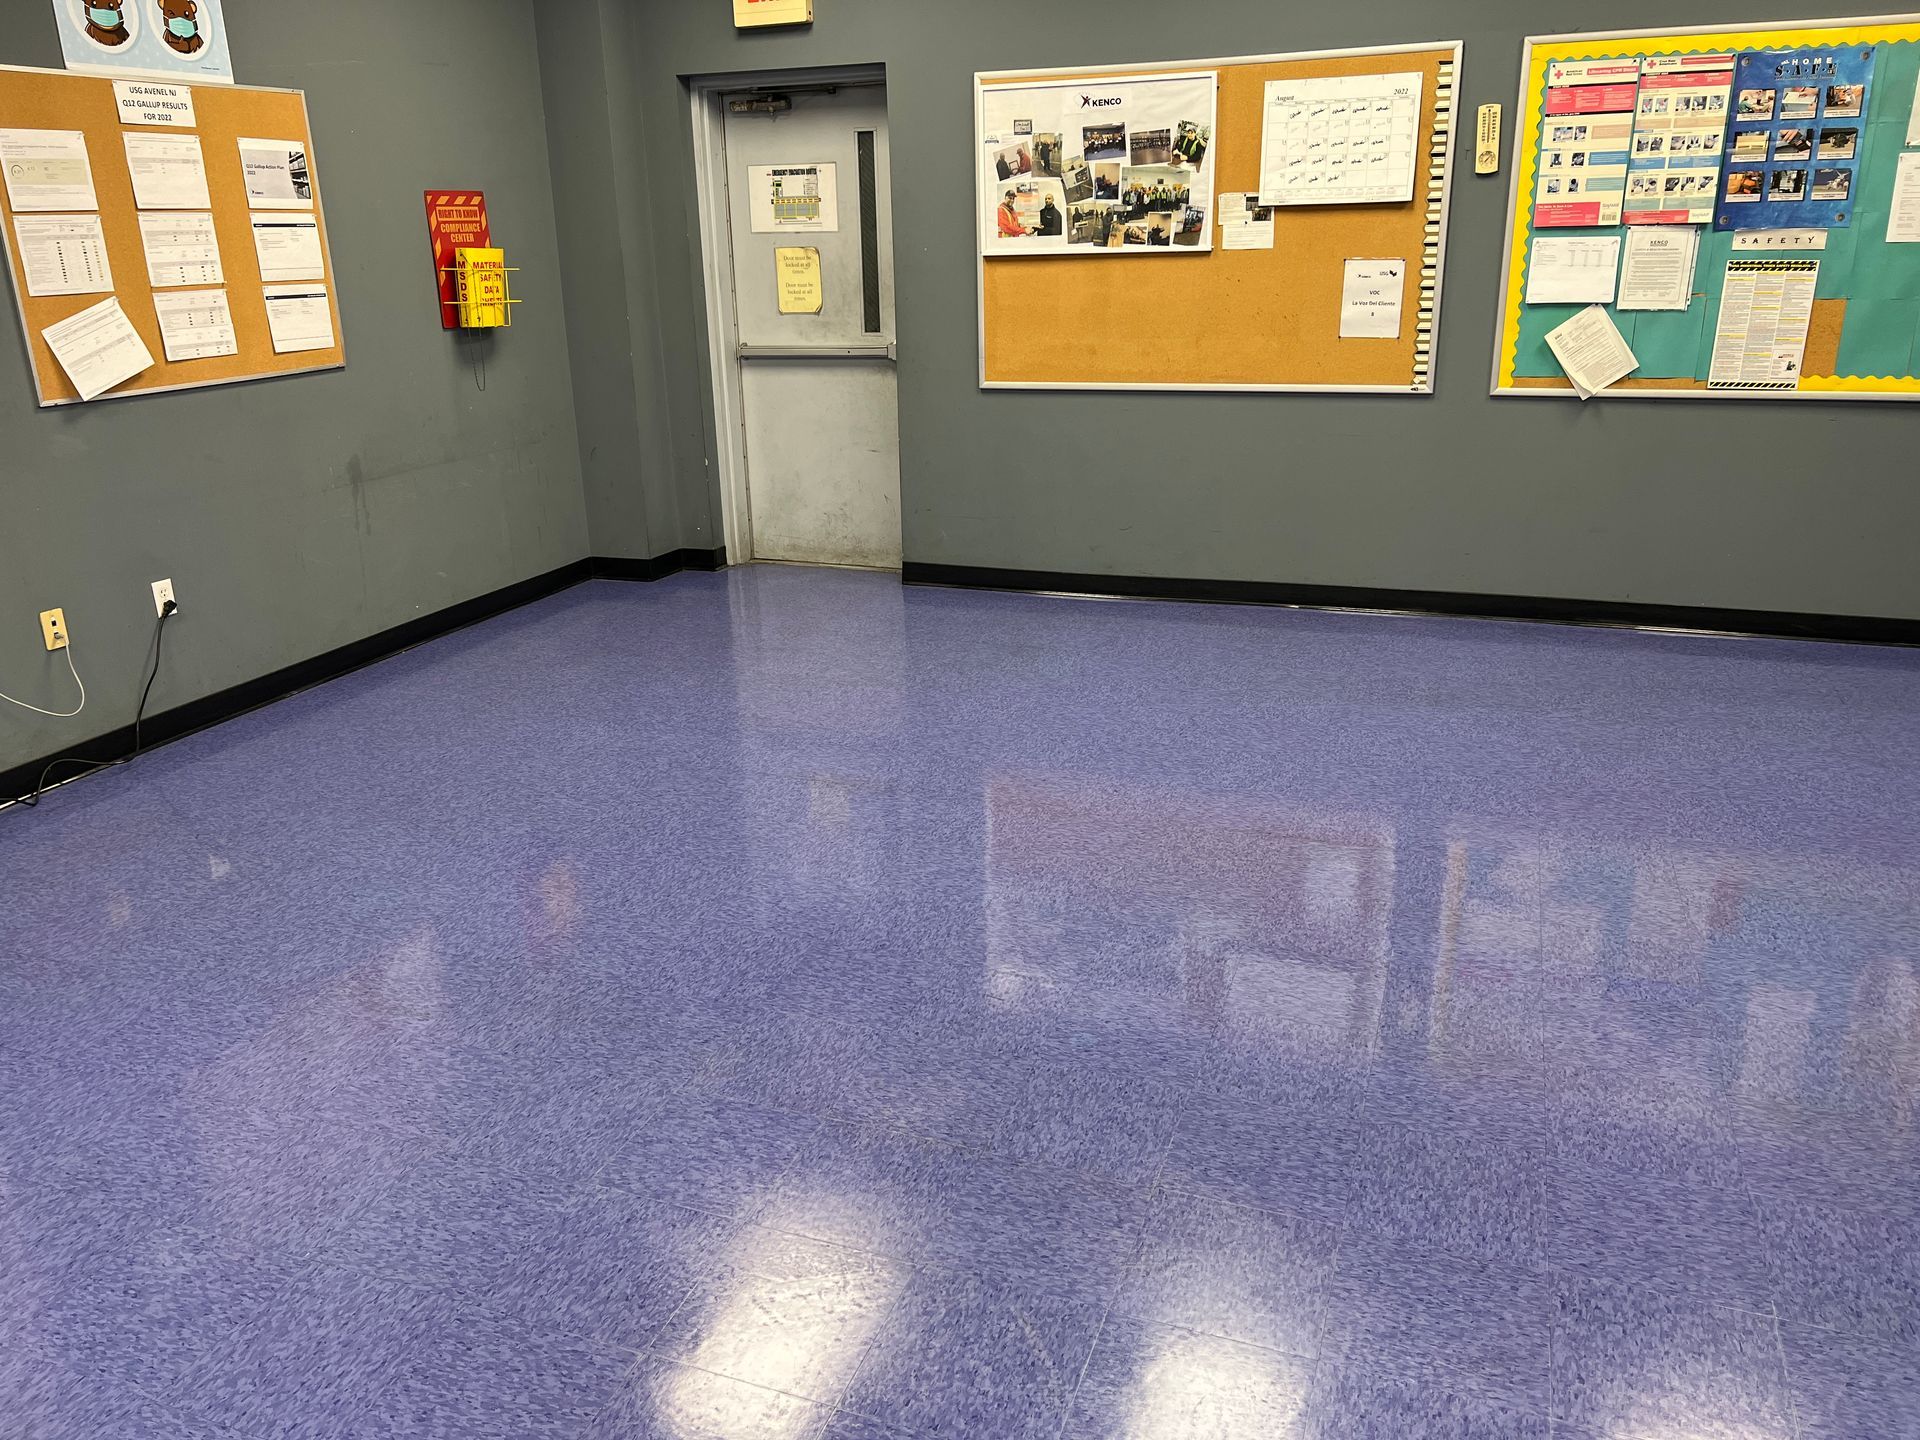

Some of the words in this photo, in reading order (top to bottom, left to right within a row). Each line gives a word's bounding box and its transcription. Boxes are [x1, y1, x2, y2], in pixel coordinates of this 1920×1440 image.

[1792, 57, 1833, 66] HOME
[144, 88, 168, 96] AVENEL
[162, 102, 188, 110] RESULTS
[1092, 97, 1122, 107] KENCO
[438, 210, 454, 218] RIGHT
[454, 209, 462, 218] TO
[463, 210, 478, 218] KNOW
[440, 223, 481, 232] COMPLIANCE
[450, 233, 475, 242] CENTER
[1740, 236, 1814, 244] SAFETY
